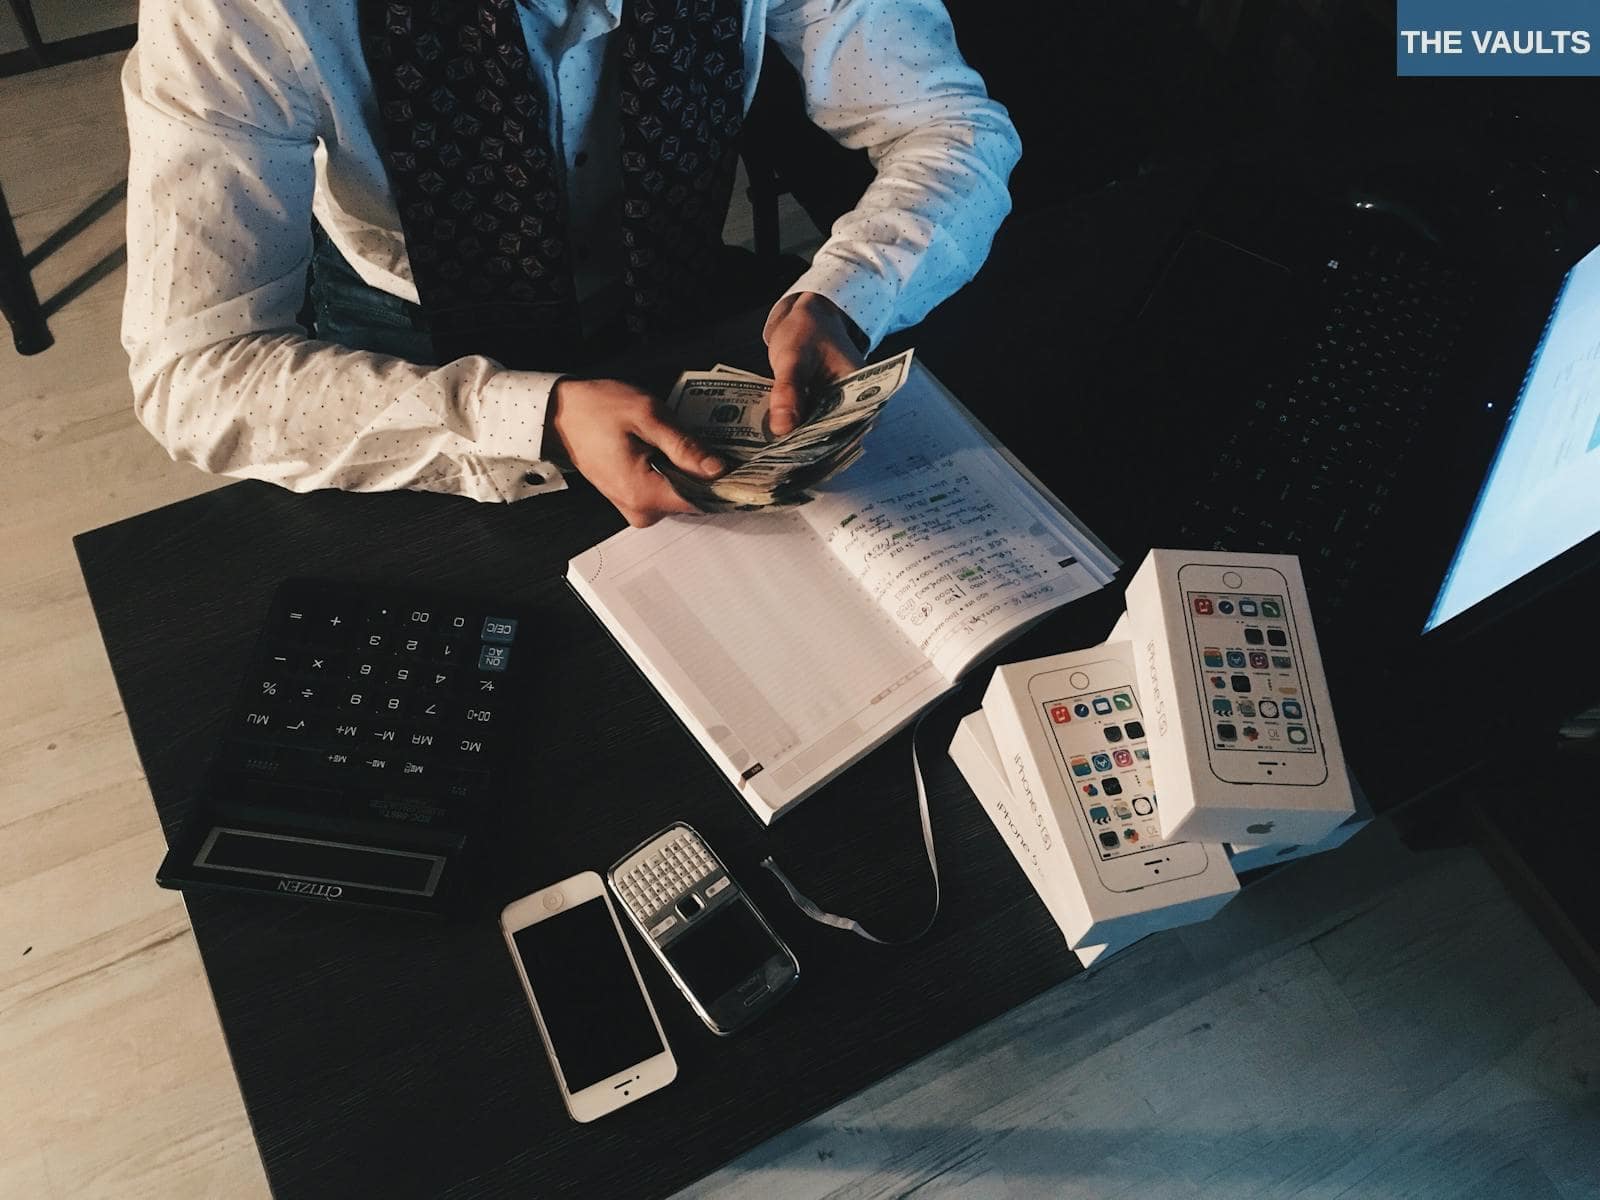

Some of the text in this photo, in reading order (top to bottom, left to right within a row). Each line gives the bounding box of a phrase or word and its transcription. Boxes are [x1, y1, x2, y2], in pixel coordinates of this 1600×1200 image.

[411, 611, 430, 623] 00
[453, 617, 465, 628] 0
[486, 623, 512, 635] CE/C
[369, 635, 382, 646] 3
[406, 639, 419, 651] 2
[444, 645, 451, 655] 1
[487, 647, 504, 657] AC
[485, 657, 501, 667] ON
[359, 664, 372, 675] 6
[397, 669, 409, 680] 5
[435, 674, 447, 684] 4
[350, 694, 362, 705] 9
[387, 698, 400, 710] 8
[425, 704, 437, 715] 7
[247, 713, 270, 726] MU
[336, 725, 358, 737] M+
[411, 734, 433, 746] MR
[460, 740, 482, 753] MC
[997, 801, 1031, 852] iPhone
[277, 879, 343, 901] CITIZEN
